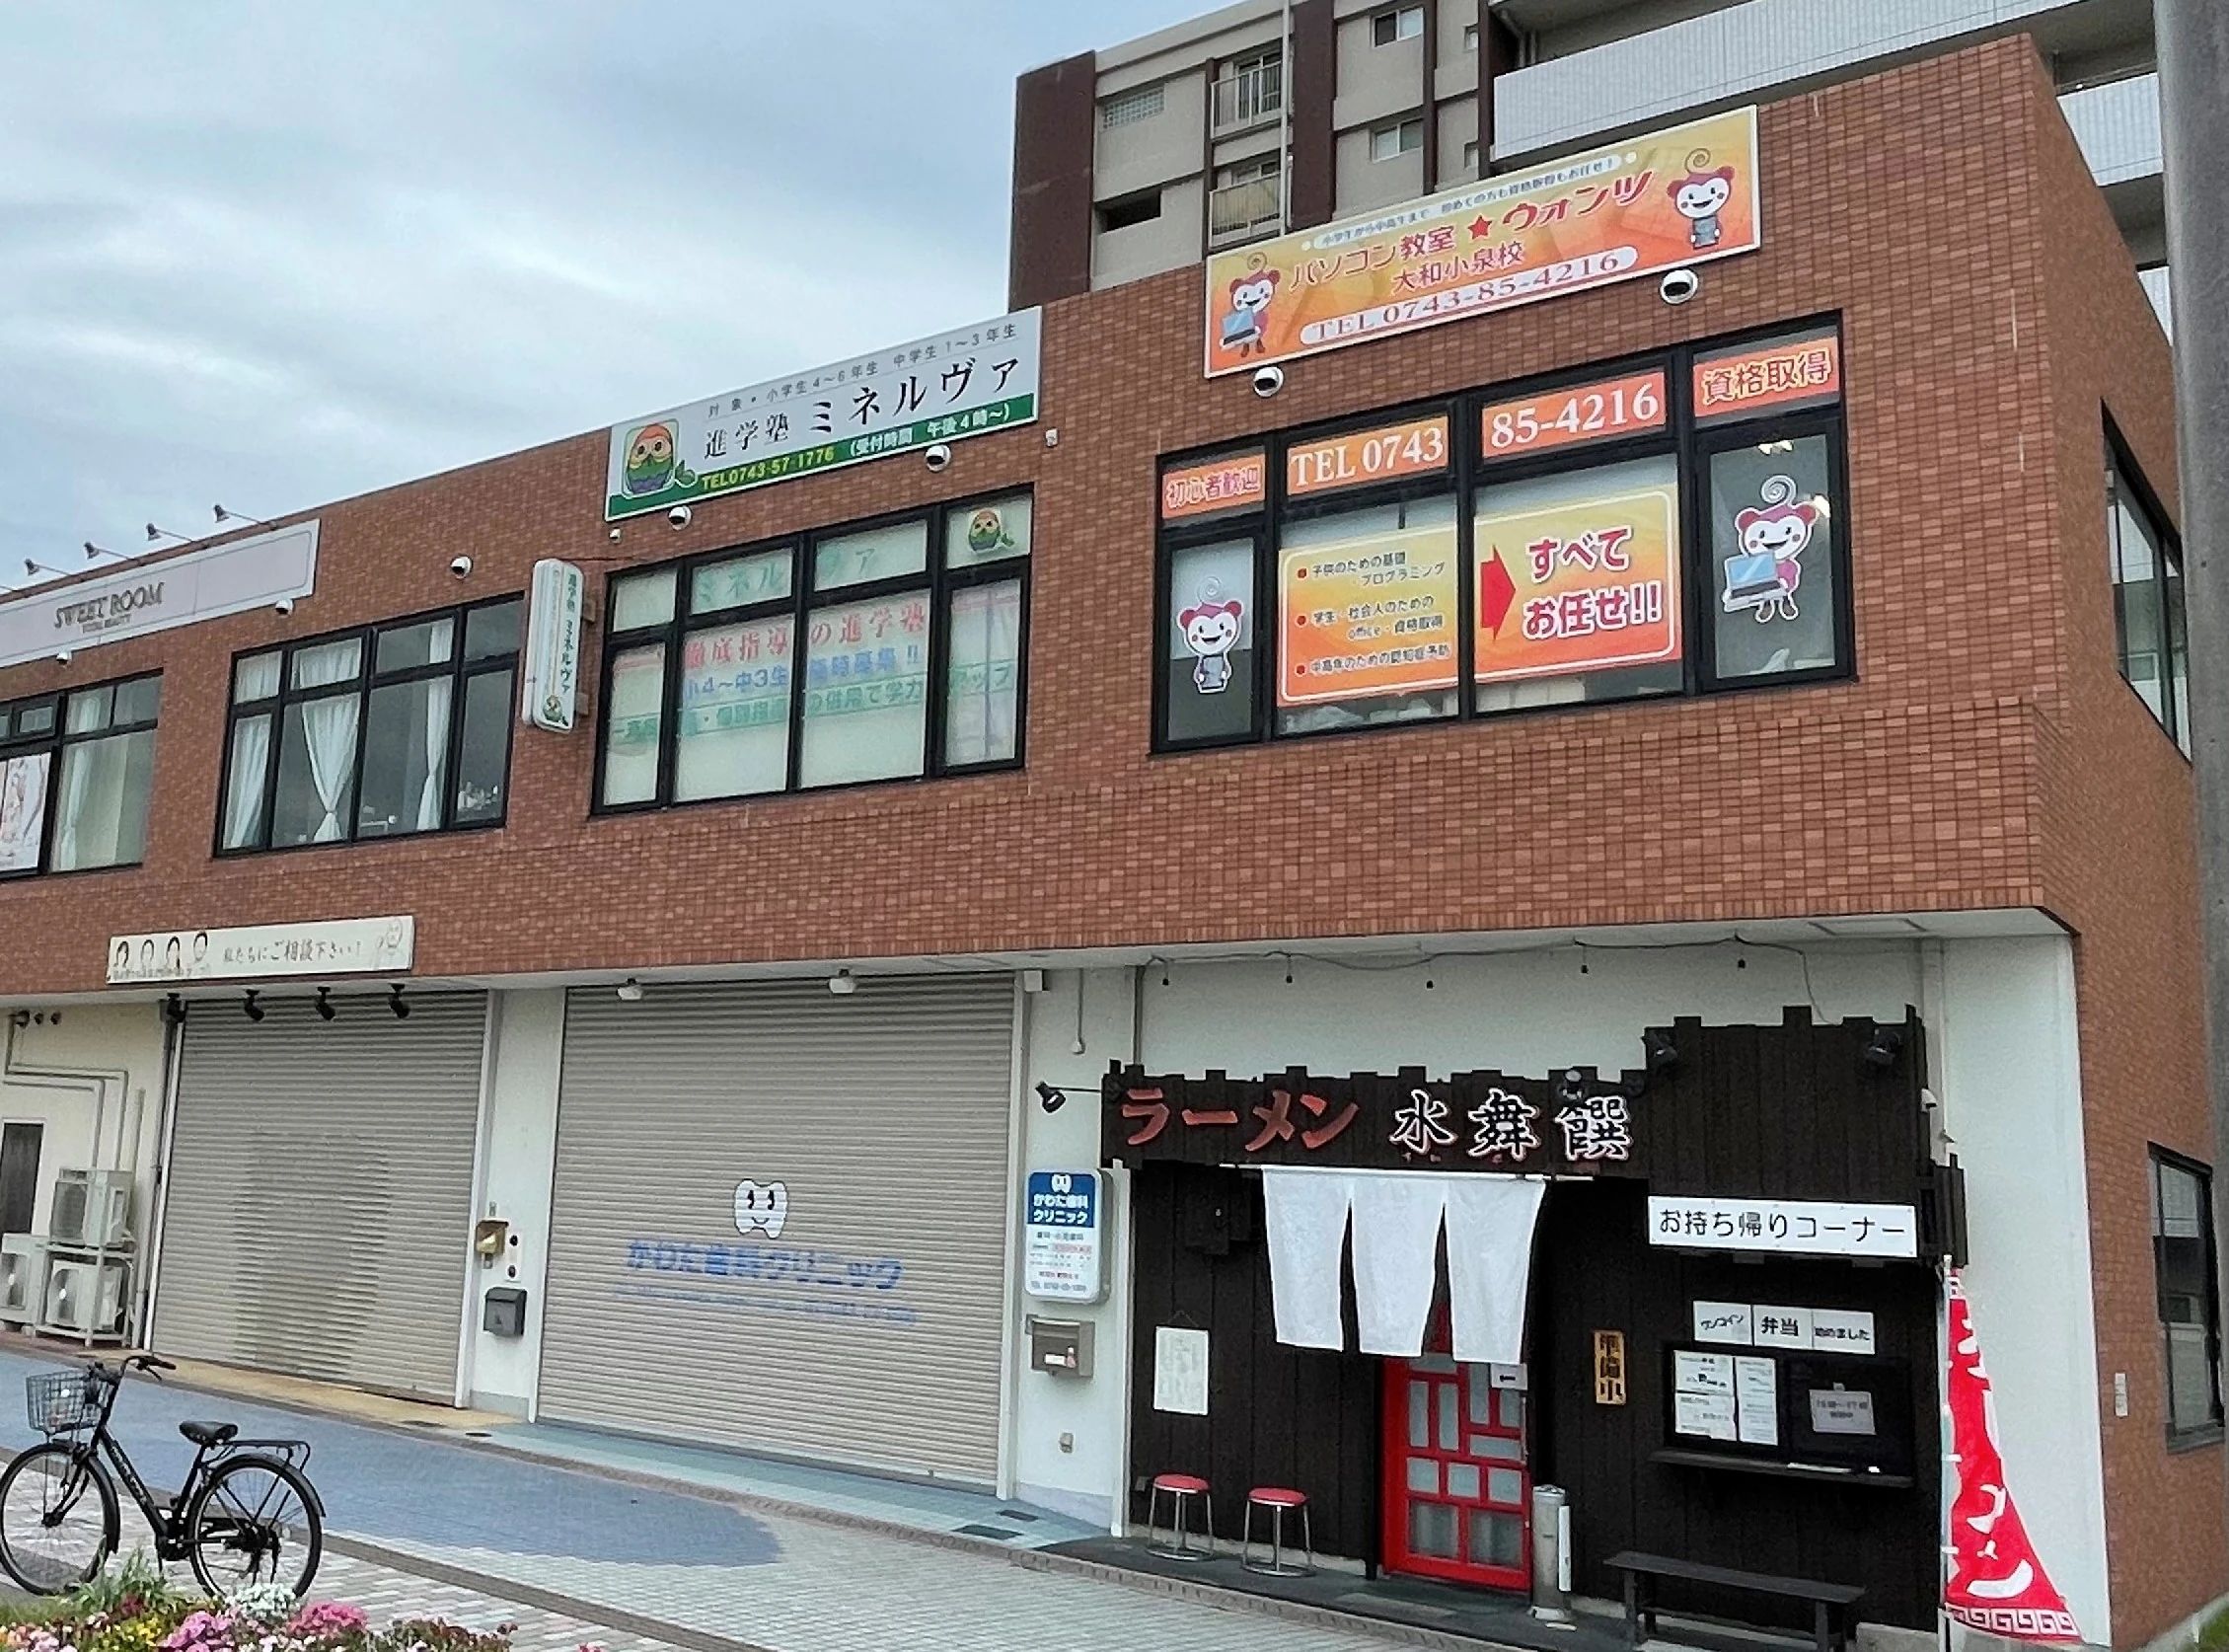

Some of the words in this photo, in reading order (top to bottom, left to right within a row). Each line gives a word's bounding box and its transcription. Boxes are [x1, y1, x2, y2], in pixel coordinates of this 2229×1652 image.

[1289, 226, 1454, 292] パソコン教室
[1502, 171, 1653, 232] ウォンツ
[1392, 241, 1526, 295] 大和小泉校
[1313, 311, 1374, 341] TEL
[1381, 252, 1619, 324] 0743-85-4216
[1701, 349, 1832, 407] 資格取得
[705, 412, 789, 461] 進学塾
[809, 356, 1019, 433] ミネルヴァ
[1491, 383, 1660, 448] 85-4216
[1166, 464, 1261, 509] 初心者歓迎
[1290, 449, 1354, 488] TEL
[1361, 429, 1446, 471] 0743
[1361, 562, 1446, 586] プログラミング
[1527, 526, 1630, 582] すべて
[111, 582, 164, 616] ROOM
[1524, 581, 1661, 638] お任せ!!
[1121, 1089, 1361, 1153] ラーメン
[1033, 1209, 1088, 1225] クリニック
[1659, 1208, 1905, 1242] お持ち帰りコーナー
[1760, 1315, 1800, 1337] 弁当
